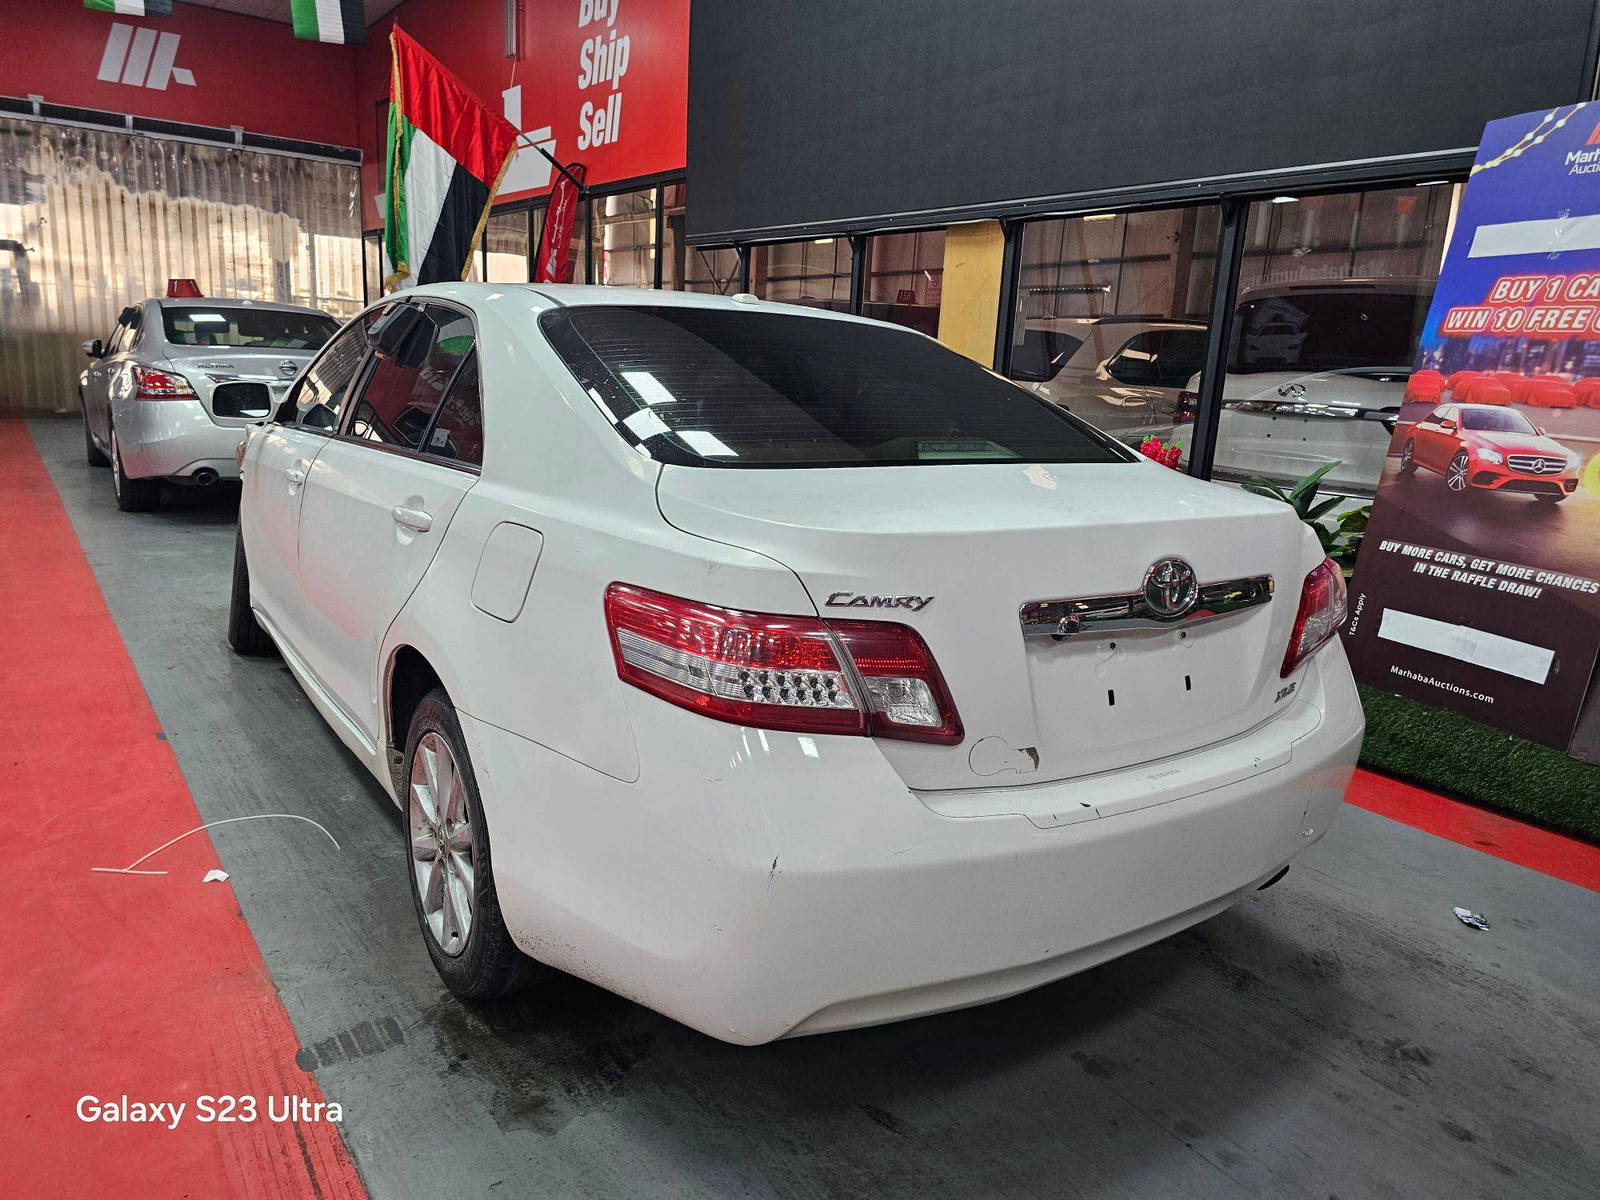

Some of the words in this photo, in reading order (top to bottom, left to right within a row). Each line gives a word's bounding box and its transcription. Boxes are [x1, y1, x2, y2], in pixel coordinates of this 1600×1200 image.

[577, 0, 620, 28] Buy
[577, 29, 631, 91] Ship
[577, 92, 623, 151] Sell
[1492, 278, 1543, 300] BUY
[1547, 279, 1562, 299] 1
[1447, 309, 1490, 329] WIN
[1494, 308, 1524, 329] 10
[1527, 308, 1592, 329] FREE
[1379, 540, 1402, 553] BUY
[1401, 545, 1434, 560] MORE
[1434, 551, 1467, 569] CARS,
[1470, 558, 1496, 572] GET
[1495, 563, 1535, 581] MORE
[1535, 571, 1600, 594] CHANCES
[1413, 562, 1428, 574] IN
[1428, 565, 1451, 579] THE
[1450, 570, 1498, 589] RAFFLE
[1497, 580, 1543, 599] DRAW!
[824, 591, 936, 612] CAMRY
[1354, 593, 1367, 616] Apply
[1390, 664, 1495, 704] MarhabaAuctions.com
